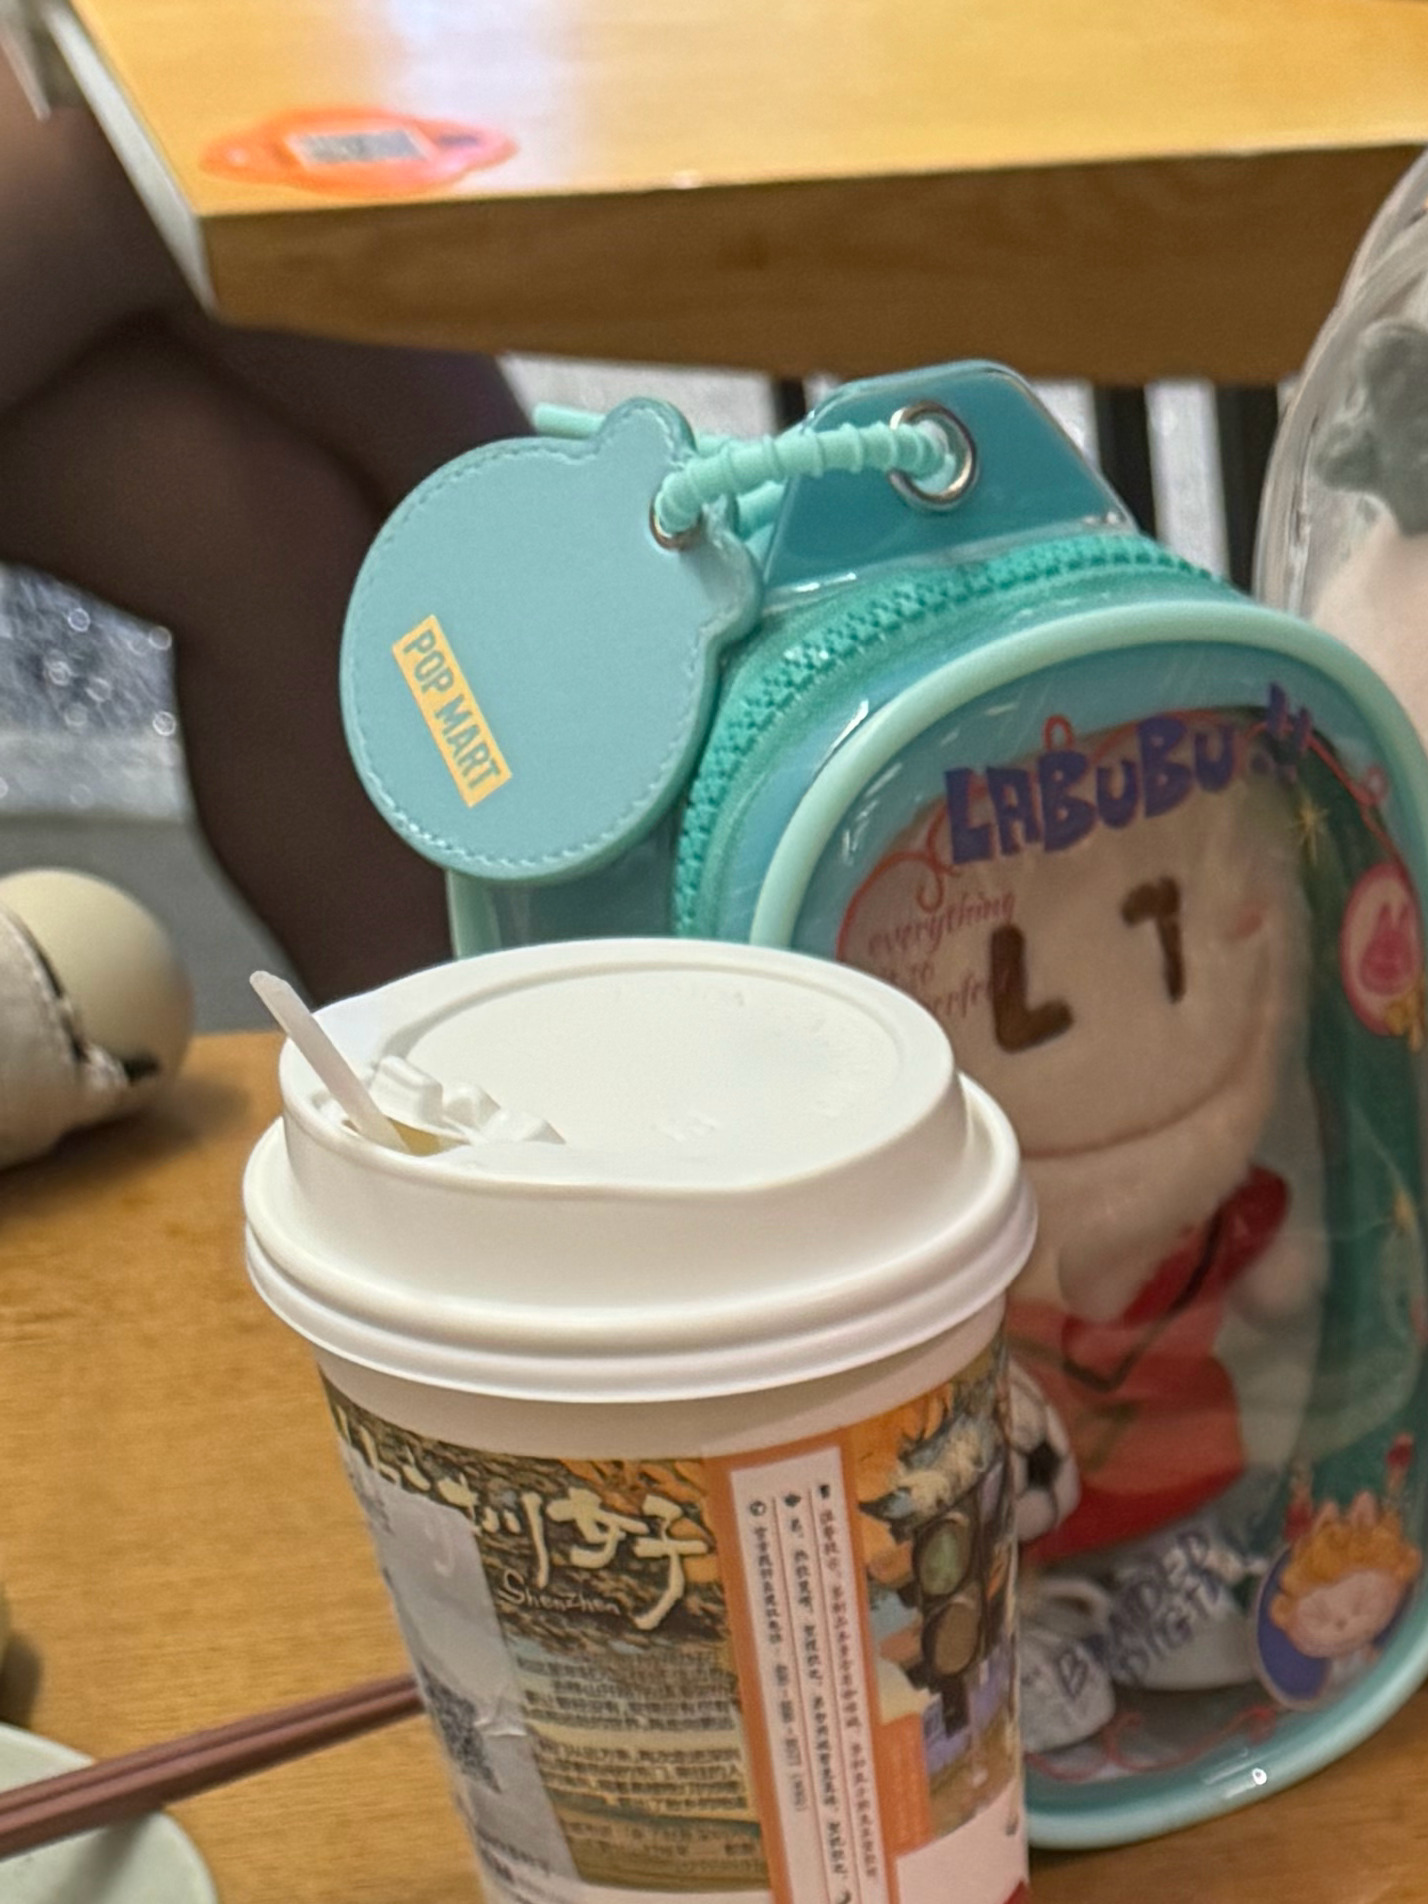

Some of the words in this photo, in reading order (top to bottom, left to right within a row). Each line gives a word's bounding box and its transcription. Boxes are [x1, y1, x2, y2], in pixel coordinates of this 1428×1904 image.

[403, 629, 455, 694] POP
[434, 694, 502, 790] MART
[944, 716, 1237, 865] LABUBU
